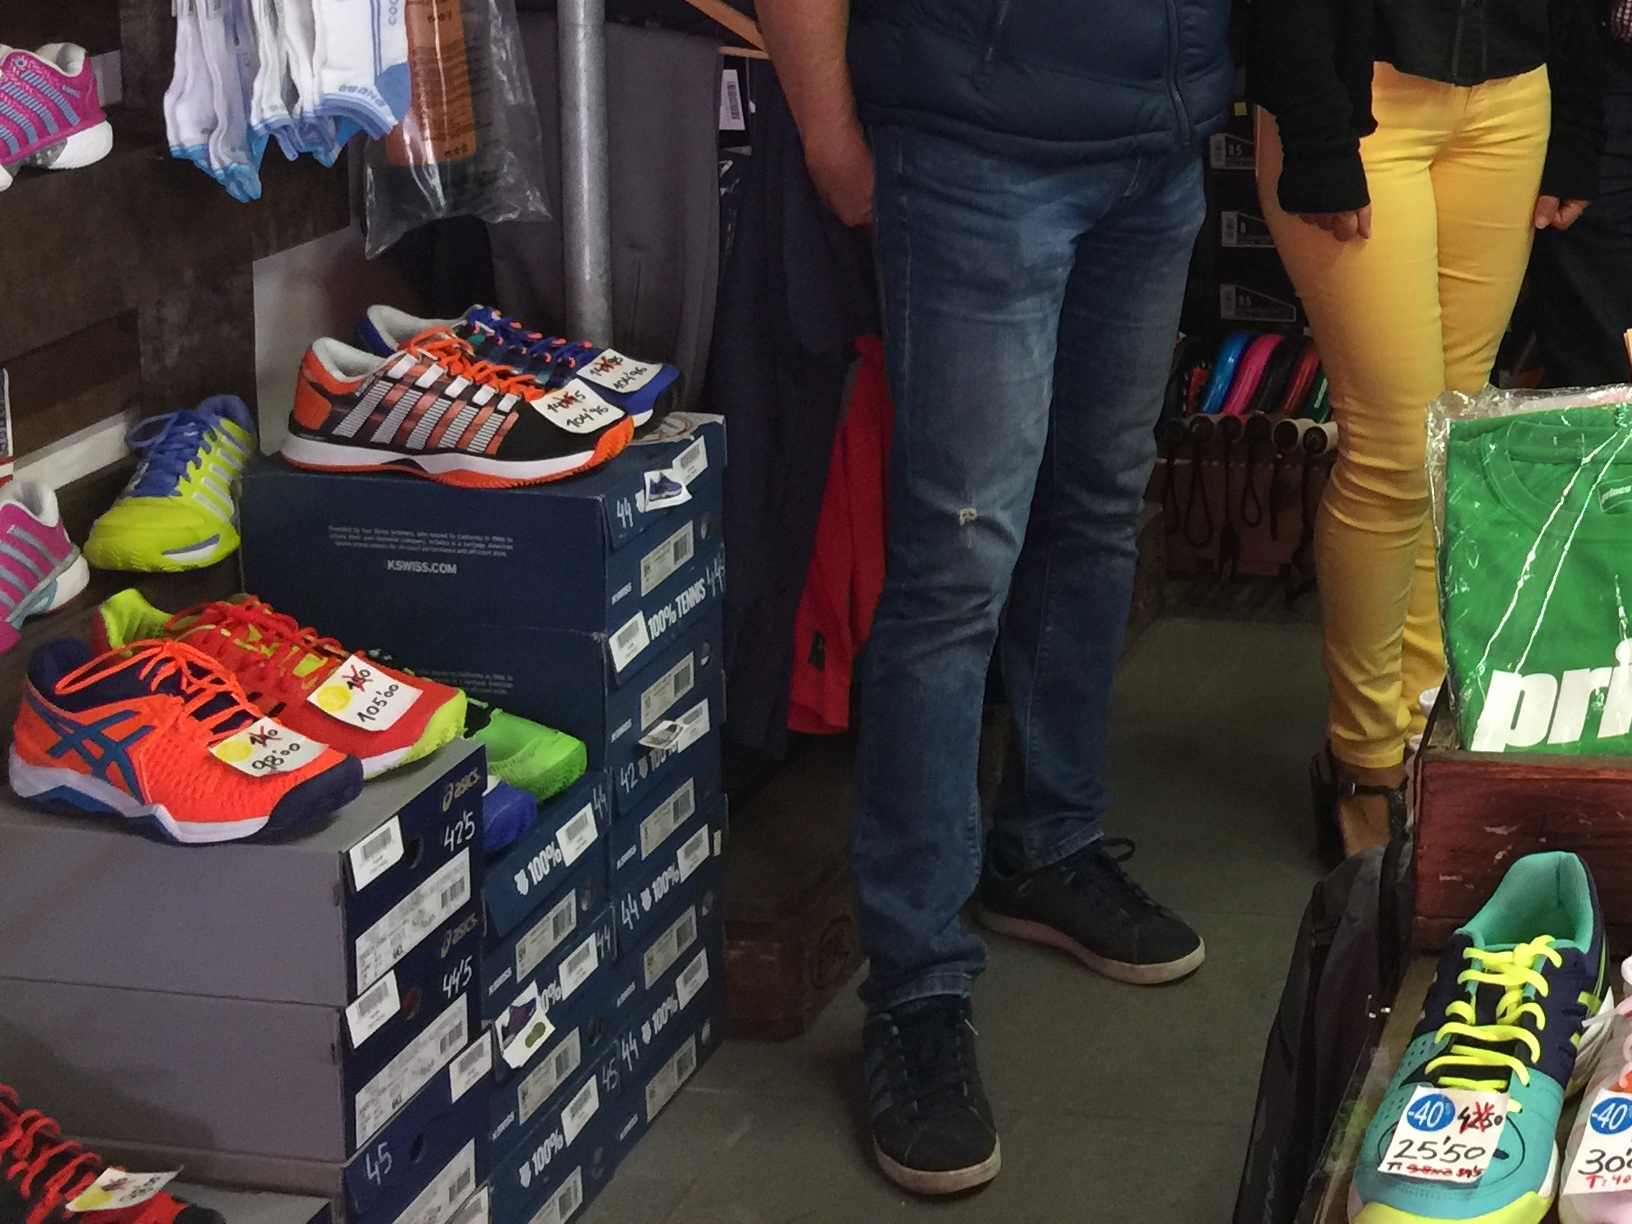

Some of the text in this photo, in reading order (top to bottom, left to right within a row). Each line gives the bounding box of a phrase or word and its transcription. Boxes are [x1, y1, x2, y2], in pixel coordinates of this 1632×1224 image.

[387, 559, 458, 576] KSWISS.COM
[648, 577, 707, 640] 100% TENNIS
[527, 840, 562, 886] 100%
[365, 1141, 393, 1186] 45
[531, 1127, 564, 1176] 100%
[1393, 1135, 1486, 1164] 25'50
